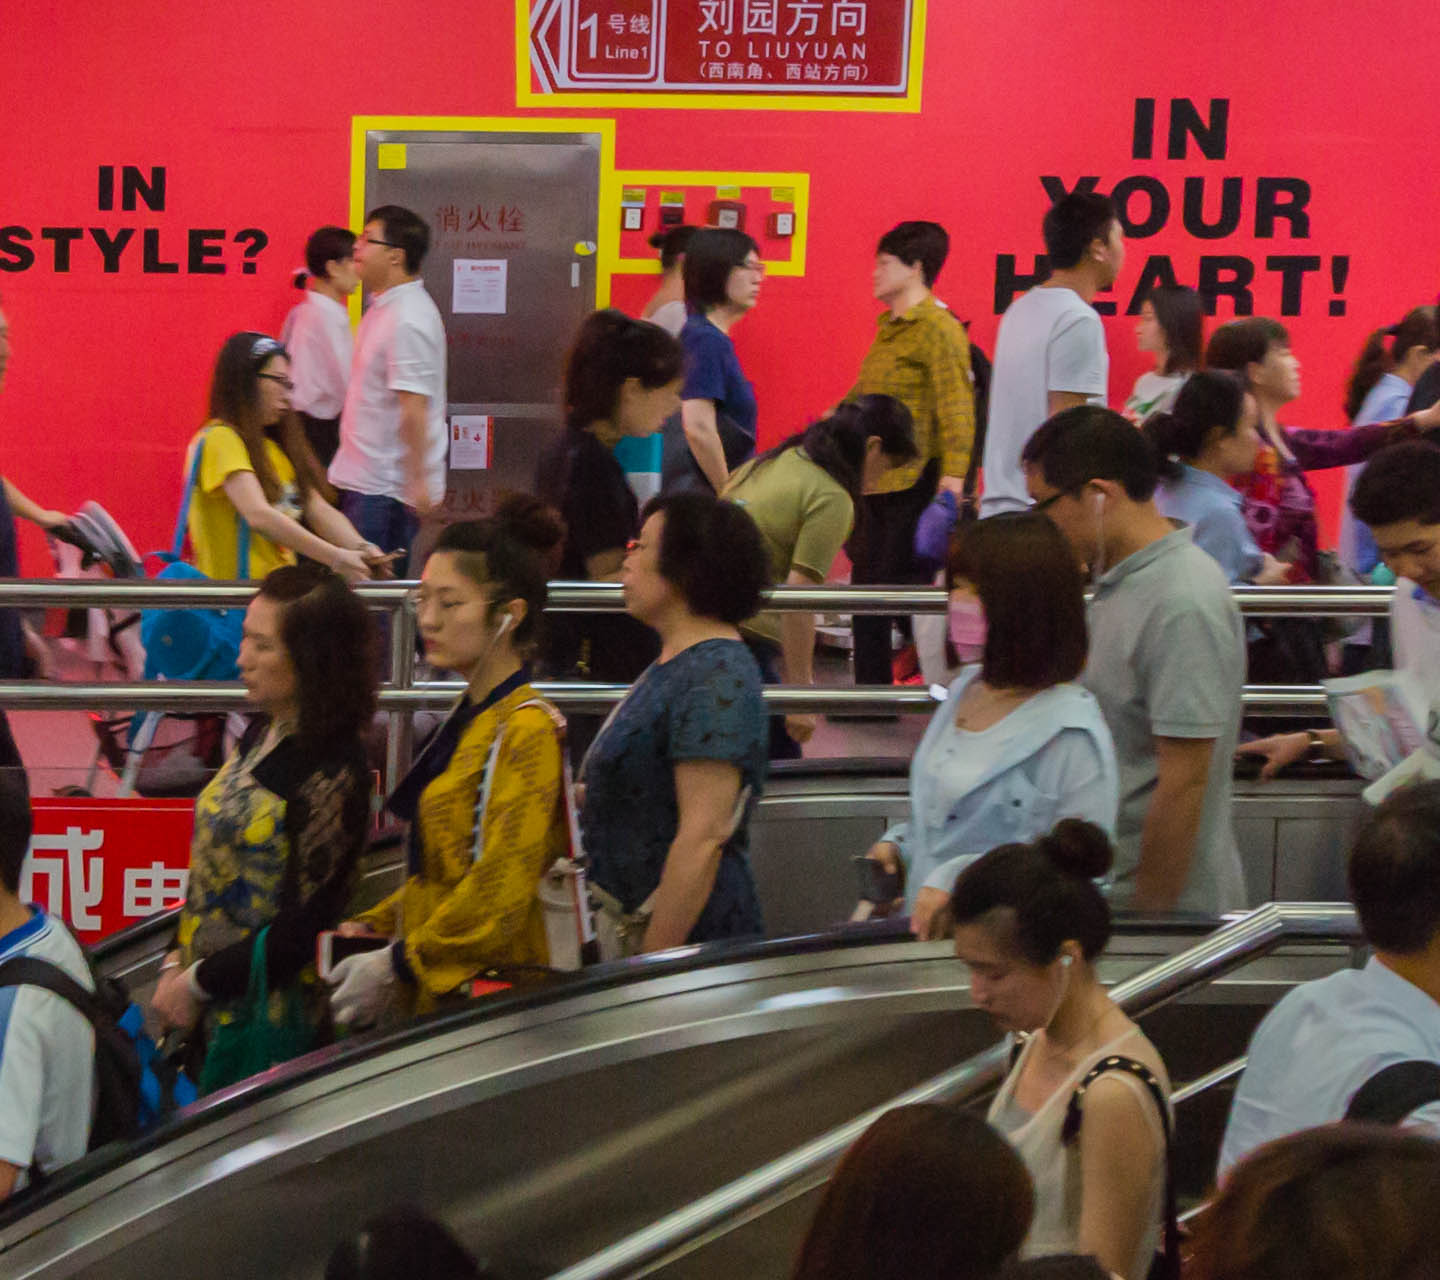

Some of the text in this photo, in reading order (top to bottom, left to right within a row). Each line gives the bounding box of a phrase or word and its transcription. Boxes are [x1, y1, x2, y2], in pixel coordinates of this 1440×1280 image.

[579, 12, 598, 59] 1
[605, 45, 648, 60] Line1
[698, 40, 866, 60] TO LIUYUAN
[1132, 98, 1230, 160] IN
[97, 166, 167, 212] IN
[436, 204, 525, 233] 消火栓
[993, 255, 1350, 317] HART!
